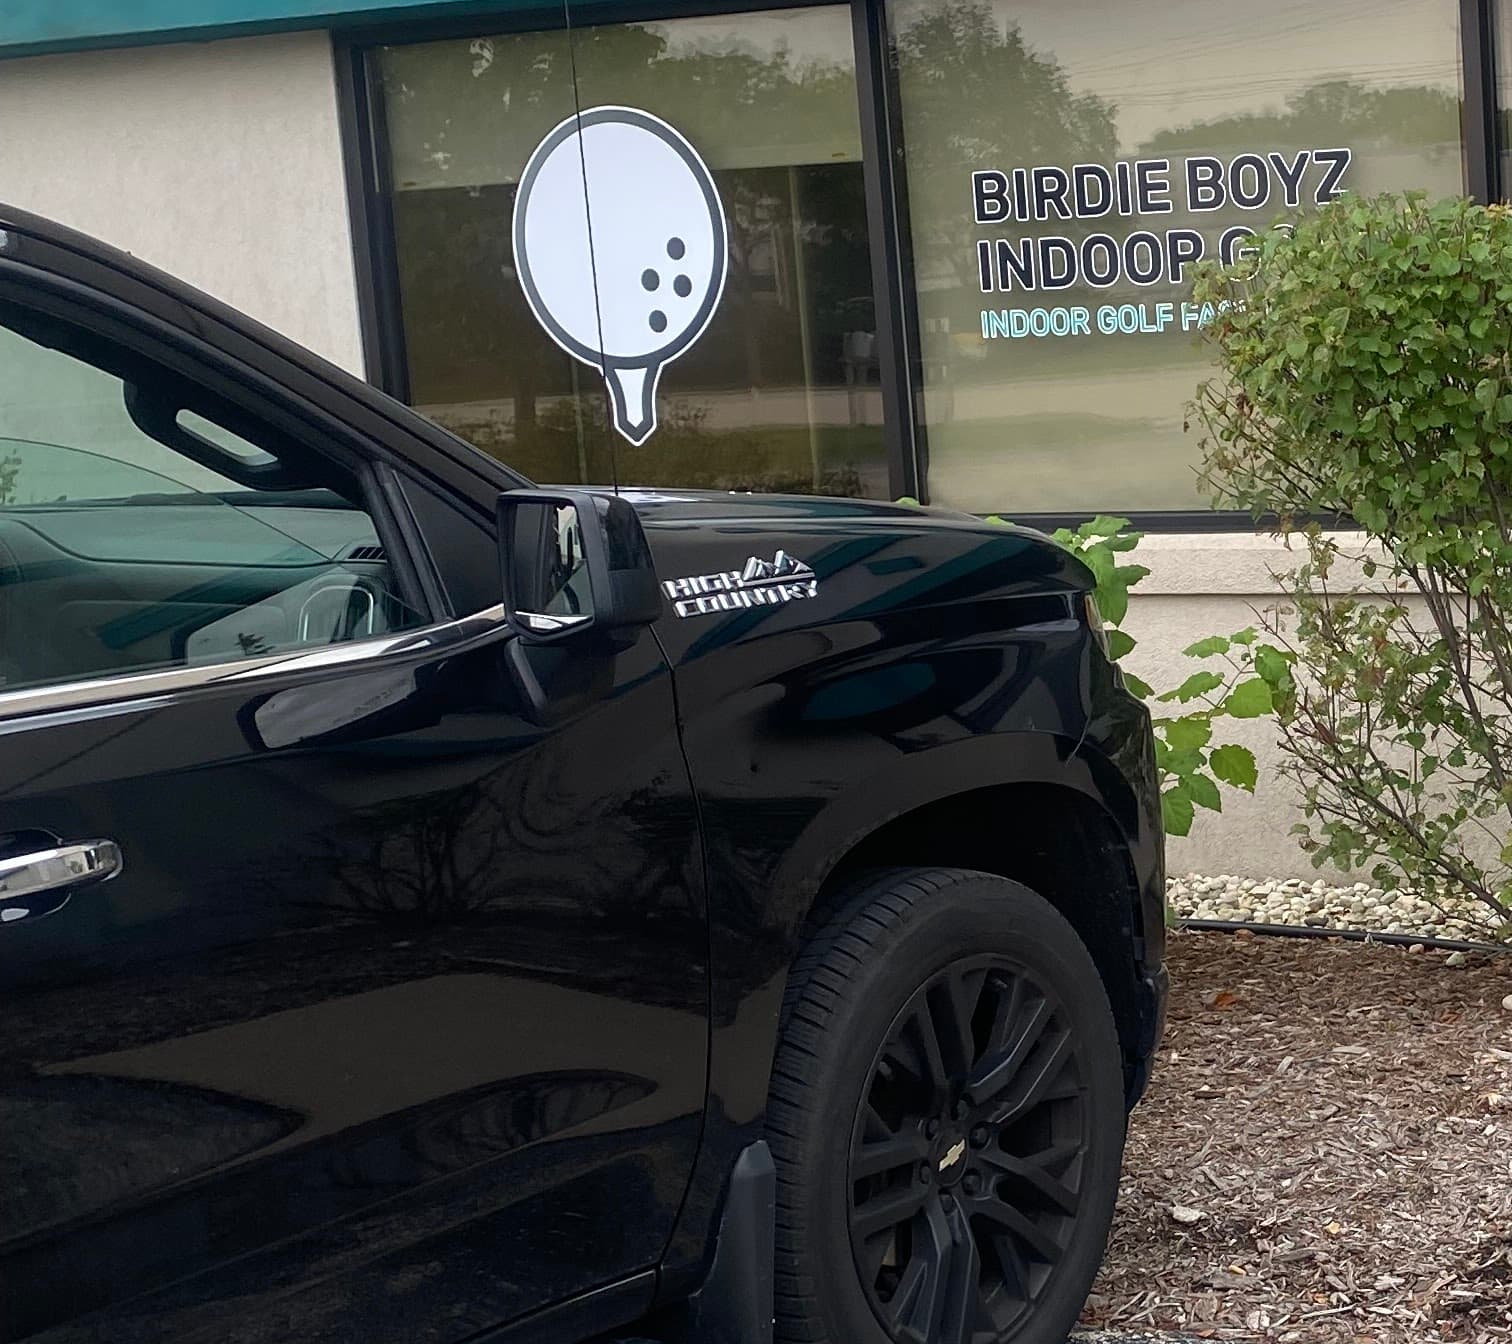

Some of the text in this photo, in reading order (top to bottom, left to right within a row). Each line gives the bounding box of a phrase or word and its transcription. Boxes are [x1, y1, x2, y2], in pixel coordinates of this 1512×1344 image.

[972, 148, 1352, 224] BIRDIE BOYZ
[980, 305, 1091, 338] INDOOR
[1097, 302, 1175, 335] GOLF
[661, 570, 744, 600] HIGH
[673, 580, 818, 618] COUNTRY
